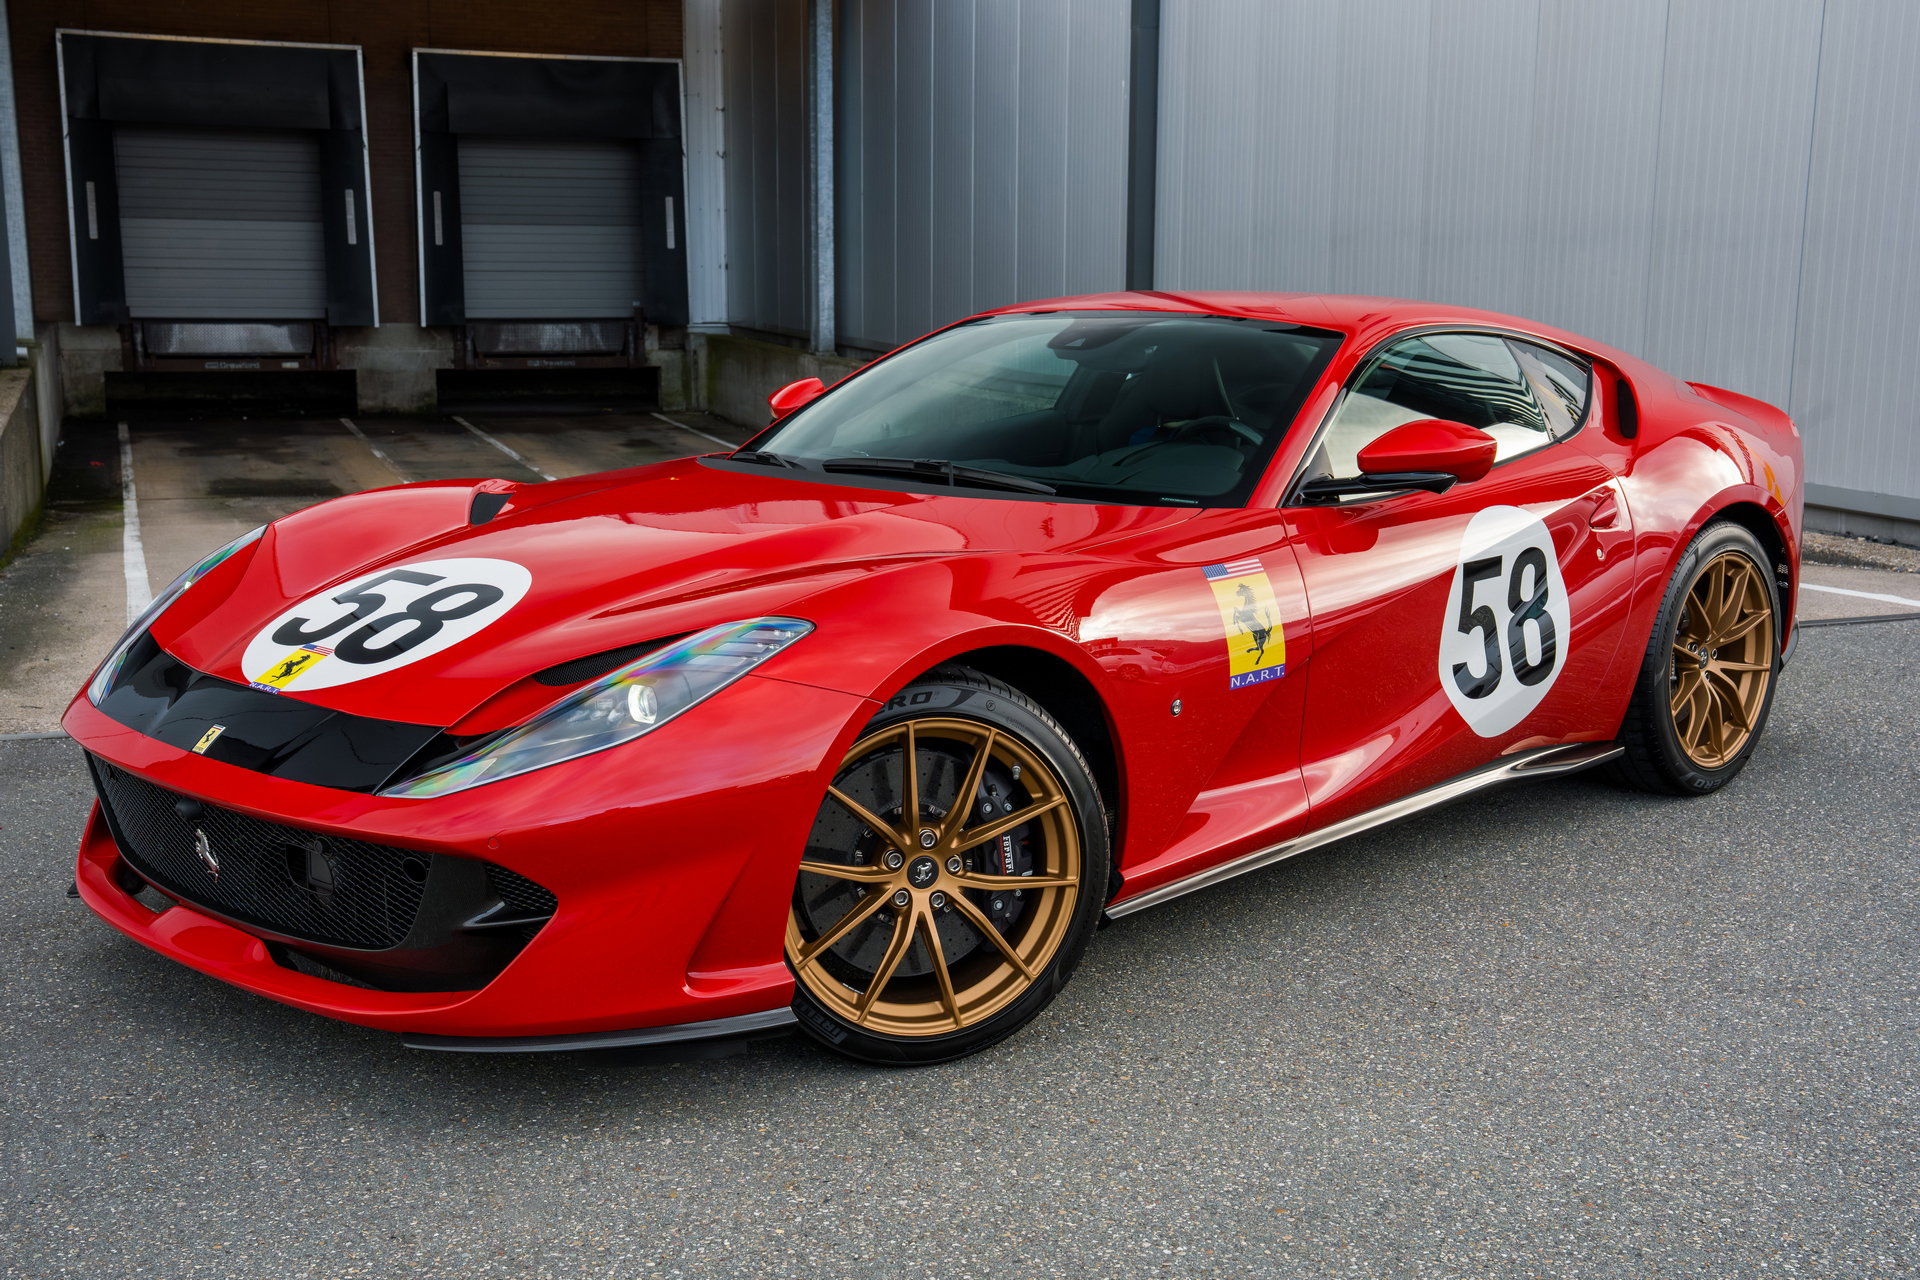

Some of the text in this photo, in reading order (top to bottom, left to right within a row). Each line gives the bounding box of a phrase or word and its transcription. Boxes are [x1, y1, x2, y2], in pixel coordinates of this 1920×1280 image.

[271, 569, 504, 664] 58
[1452, 546, 1556, 699] 58
[1230, 665, 1285, 688] N.A.R.T.
[1002, 834, 1015, 874] Ferrari
